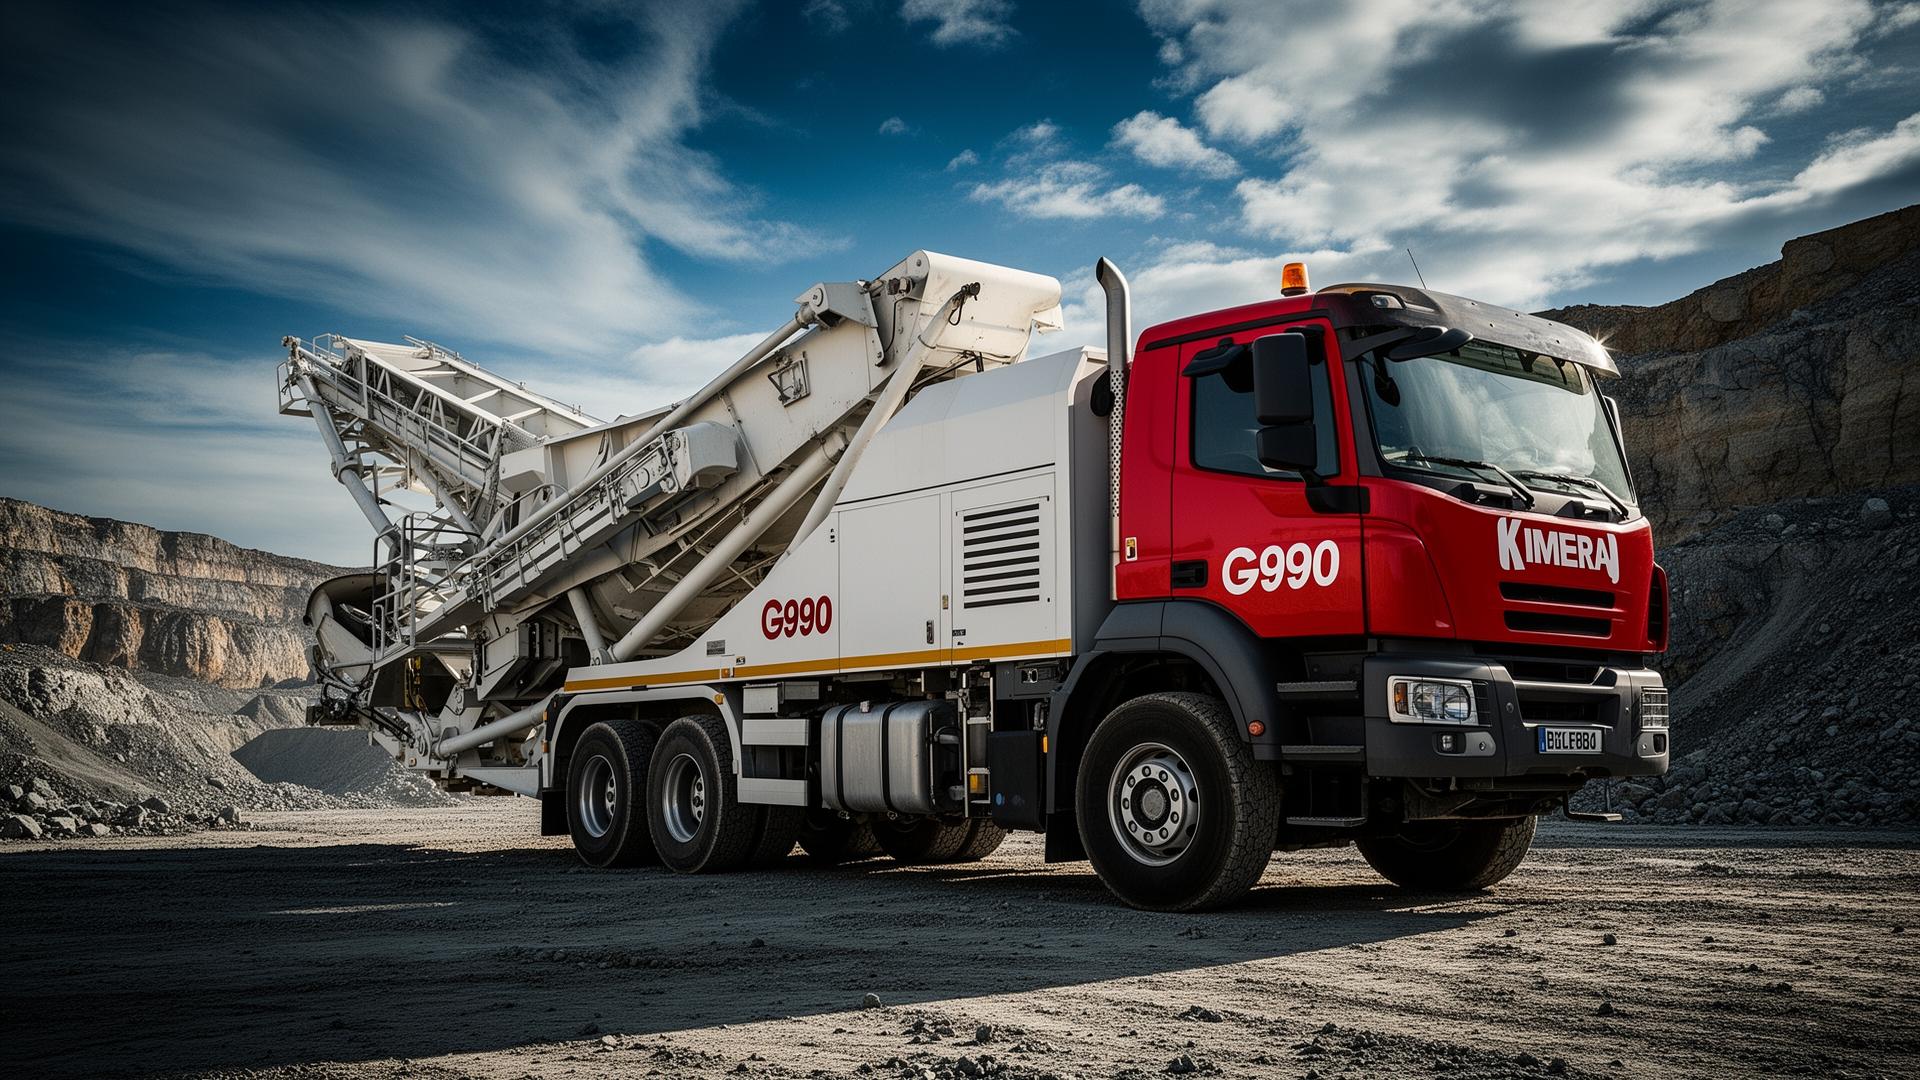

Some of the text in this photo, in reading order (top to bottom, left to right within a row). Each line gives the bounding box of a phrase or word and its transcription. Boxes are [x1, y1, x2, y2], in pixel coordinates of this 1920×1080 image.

[1222, 540, 1340, 596] G990
[1497, 517, 1620, 584] KIMERA
[761, 595, 832, 640] G990
